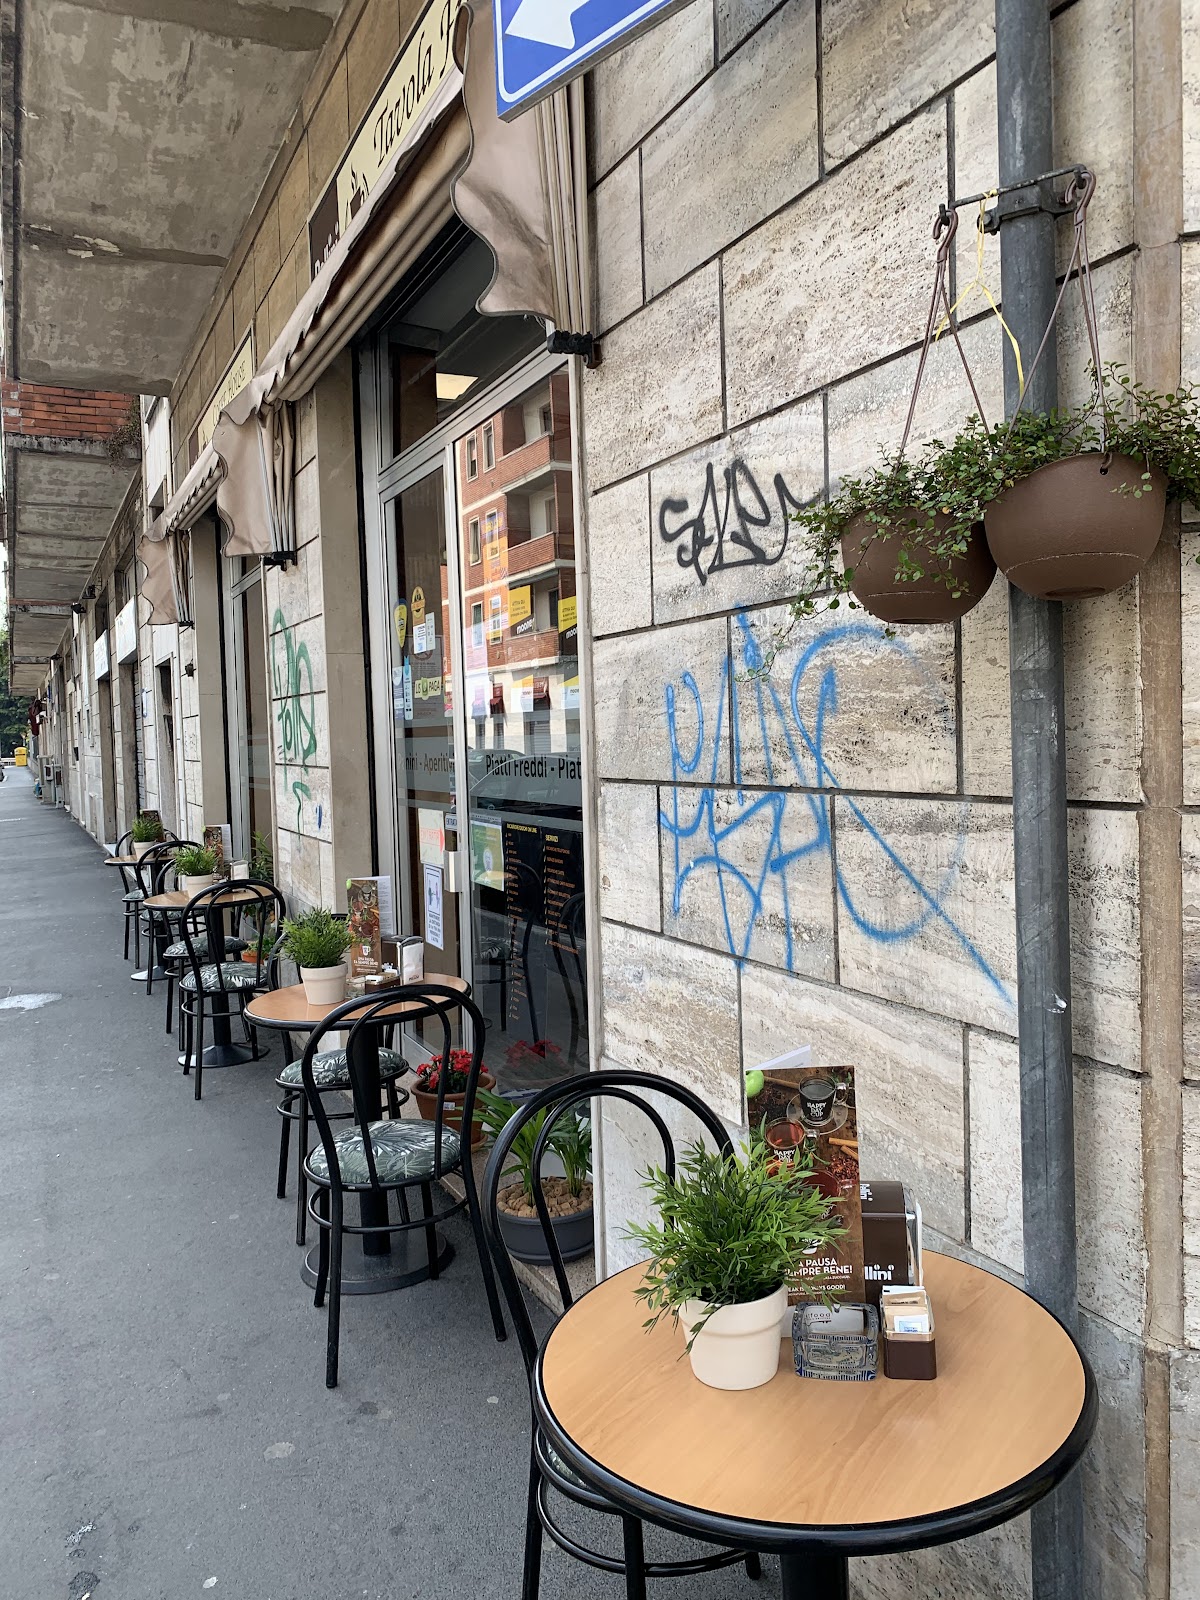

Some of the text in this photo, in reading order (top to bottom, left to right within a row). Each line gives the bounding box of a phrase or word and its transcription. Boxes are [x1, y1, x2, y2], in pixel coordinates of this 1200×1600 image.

[373, 30, 435, 168] Tavola
[485, 753, 511, 776] Piatti
[514, 754, 547, 778] Freddi
[806, 1101, 826, 1109] HAPPY
[805, 1257, 837, 1267] PAUSA
[823, 1264, 853, 1276] BENE!
[864, 1264, 895, 1280] llini
